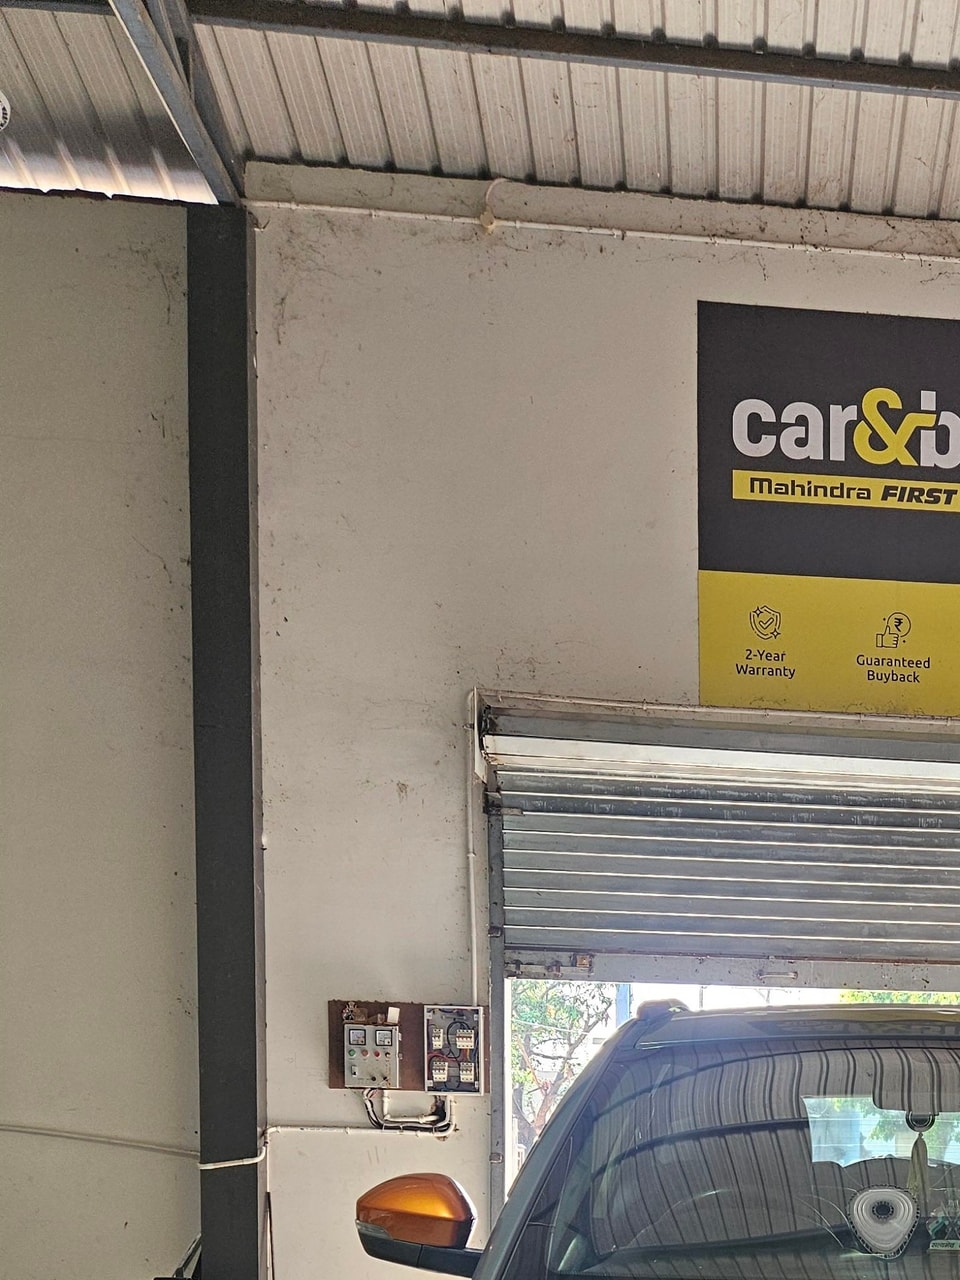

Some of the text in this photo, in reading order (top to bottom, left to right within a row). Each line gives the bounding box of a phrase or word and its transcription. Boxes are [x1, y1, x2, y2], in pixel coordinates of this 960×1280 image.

[749, 477, 871, 500] Mahindra
[881, 485, 957, 507] FIRST
[745, 648, 787, 662] 2-Year
[855, 654, 931, 669] Guaranteed
[735, 663, 796, 679] Warranty
[866, 670, 921, 684] Buyback
